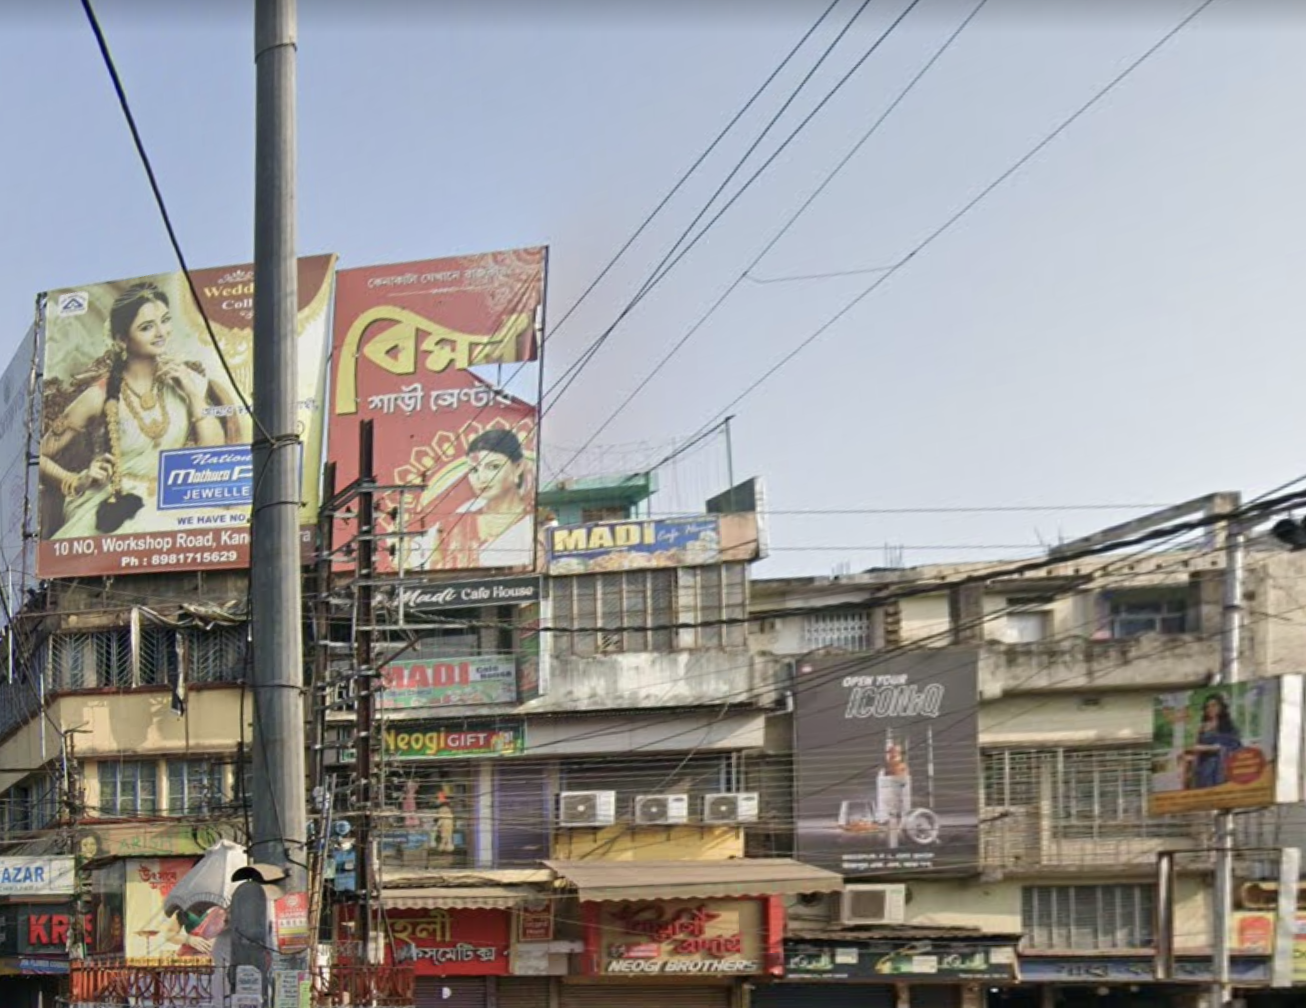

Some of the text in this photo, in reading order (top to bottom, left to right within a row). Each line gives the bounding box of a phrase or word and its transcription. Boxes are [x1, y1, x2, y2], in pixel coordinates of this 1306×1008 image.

[203, 283, 255, 298] Wedd
[191, 451, 253, 465] Nation
[167, 468, 231, 485] Mathura
[183, 486, 251, 500] JEWELLE
[177, 516, 194, 525] WE
[197, 515, 226, 524] HAVE
[53, 532, 216, 556] 10 NO, Workshop Road,
[554, 522, 655, 552] MADI
[121, 556, 138, 567] Ph
[152, 551, 237, 565] 8981715629
[461, 586, 490, 600] Cafe
[493, 585, 534, 598] House
[447, 732, 488, 747] GIFT
[607, 958, 758, 974] NEOGI BROTHERS
